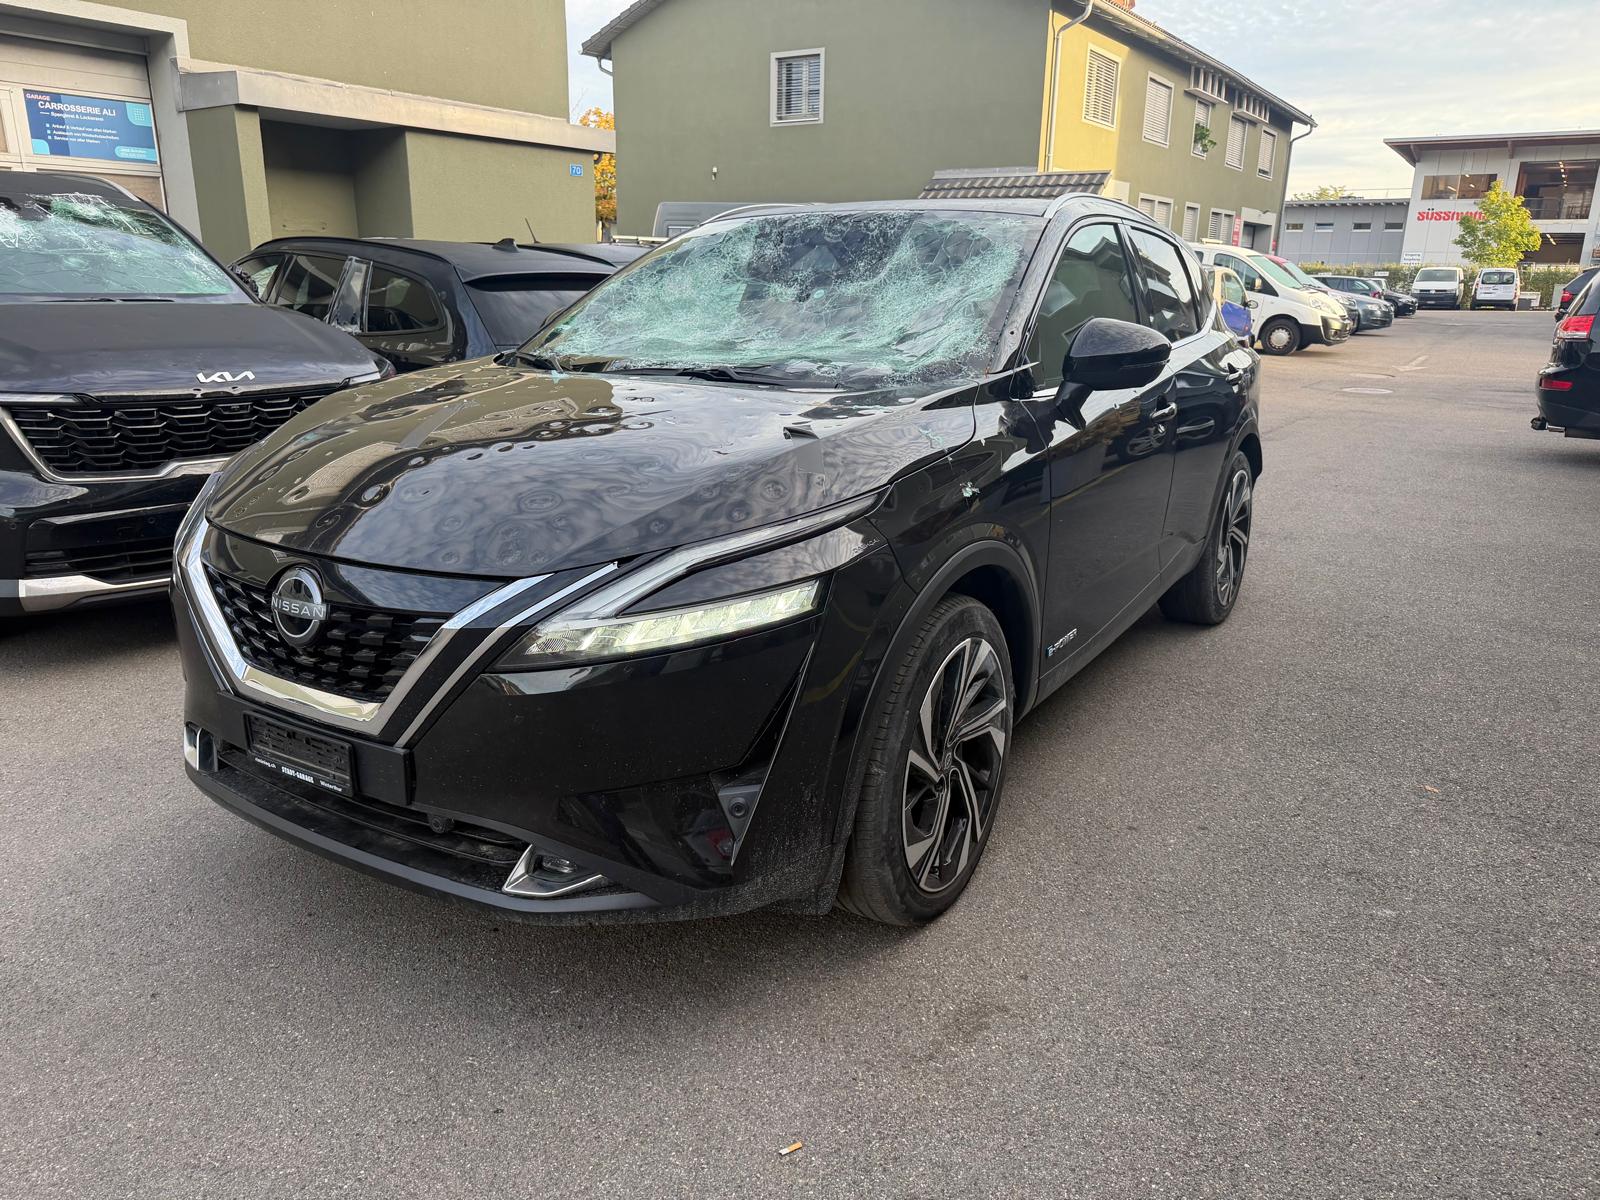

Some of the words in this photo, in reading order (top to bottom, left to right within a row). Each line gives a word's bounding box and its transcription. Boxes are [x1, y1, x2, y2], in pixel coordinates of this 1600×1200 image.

[26, 93, 50, 101] GARAGE
[38, 101, 101, 114] CARROSSERIE
[102, 108, 116, 117] ALI
[571, 166, 582, 176] 70
[271, 596, 324, 618] NISSAN
